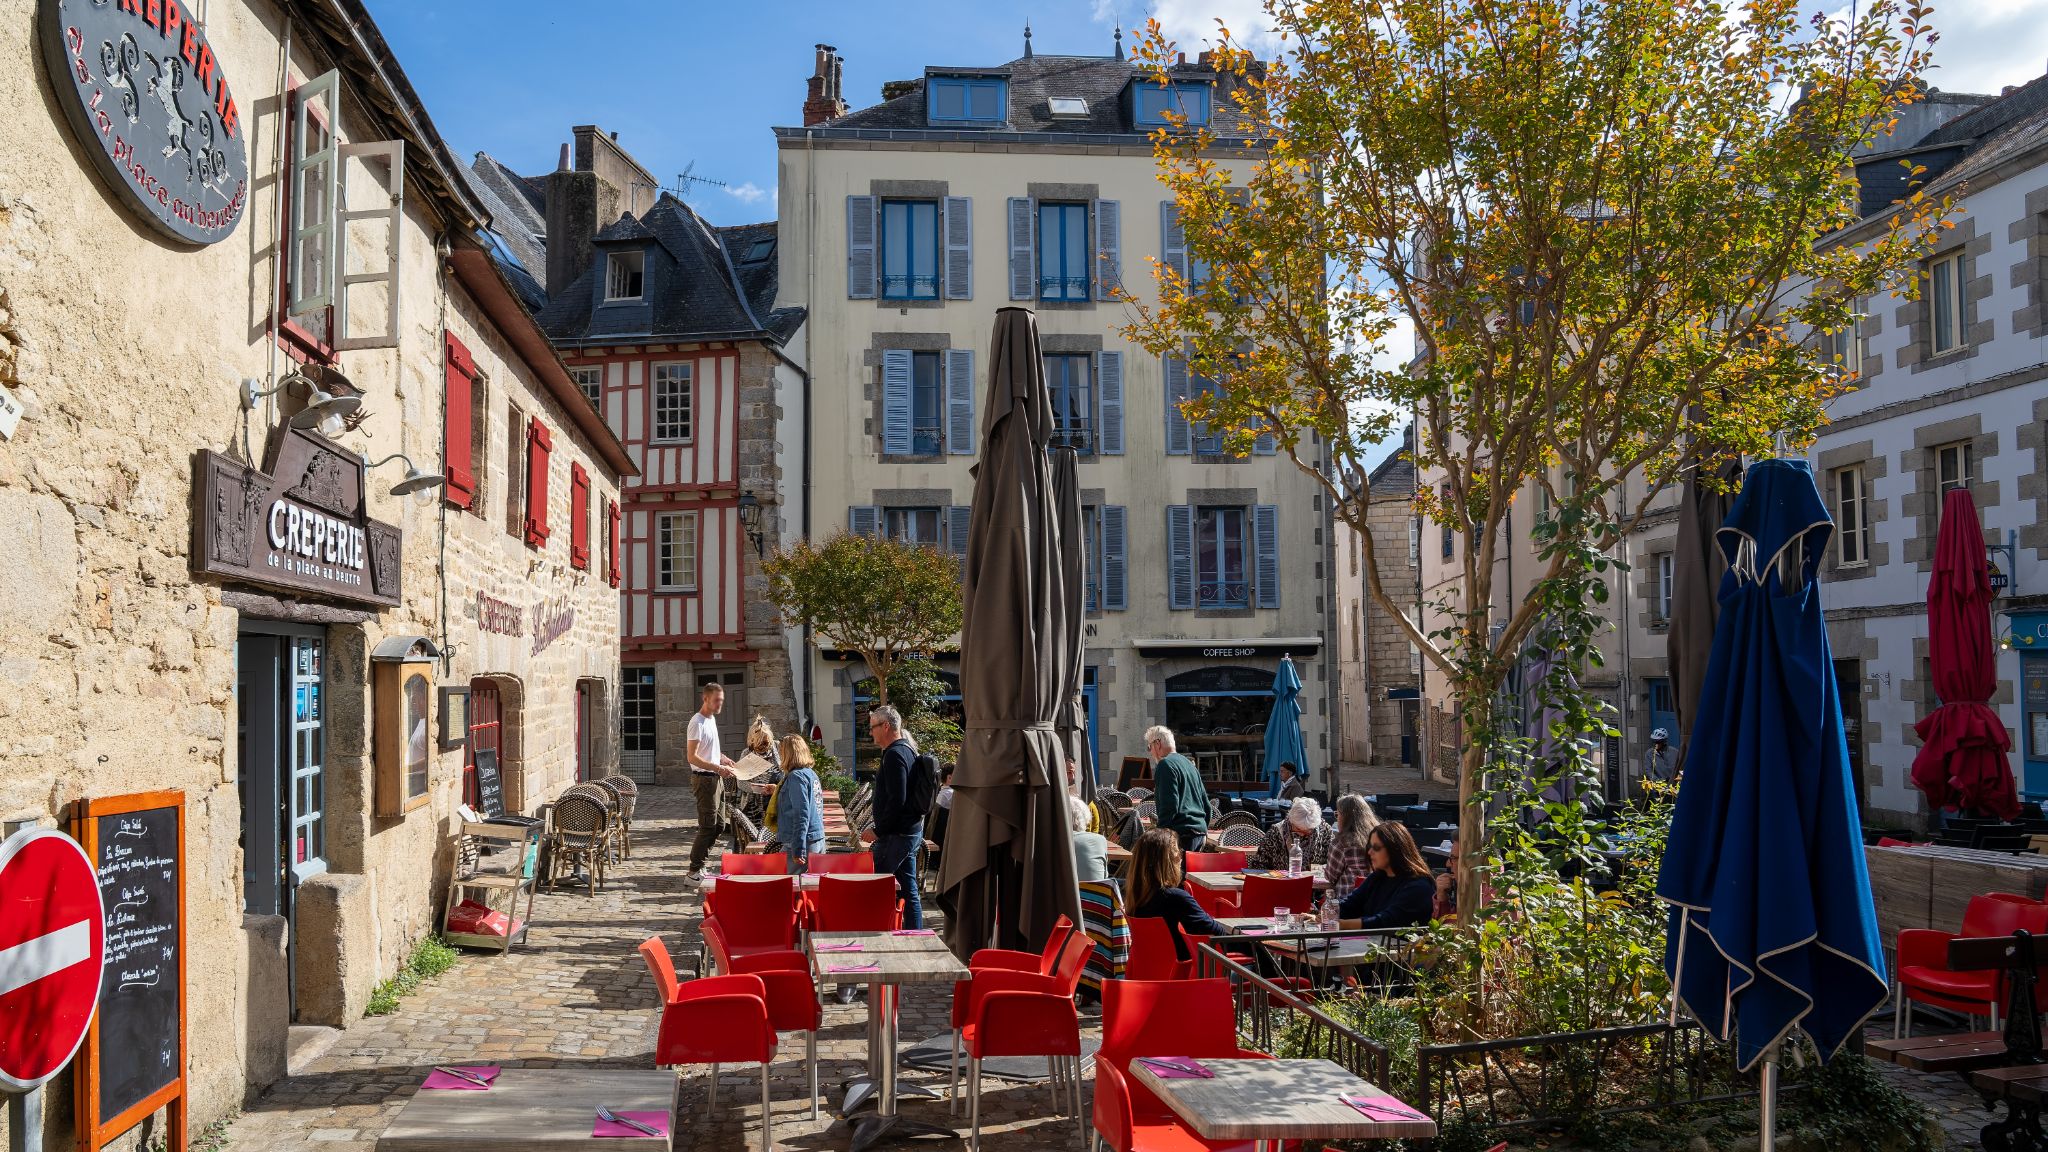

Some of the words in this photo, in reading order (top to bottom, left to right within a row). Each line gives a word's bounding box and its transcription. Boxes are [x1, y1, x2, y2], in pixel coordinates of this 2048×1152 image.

[88, 88, 115, 138] la
[112, 134, 170, 208] place
[172, 196, 196, 226] au
[196, 178, 248, 231] beurre
[271, 499, 365, 569] CREPERIE
[268, 551, 279, 567] de
[283, 555, 292, 571] la
[296, 560, 320, 576] place
[323, 567, 333, 580] au
[335, 568, 361, 586] beurre
[1203, 648, 1232, 657] COFFEE
[1235, 648, 1256, 657] SHOP
